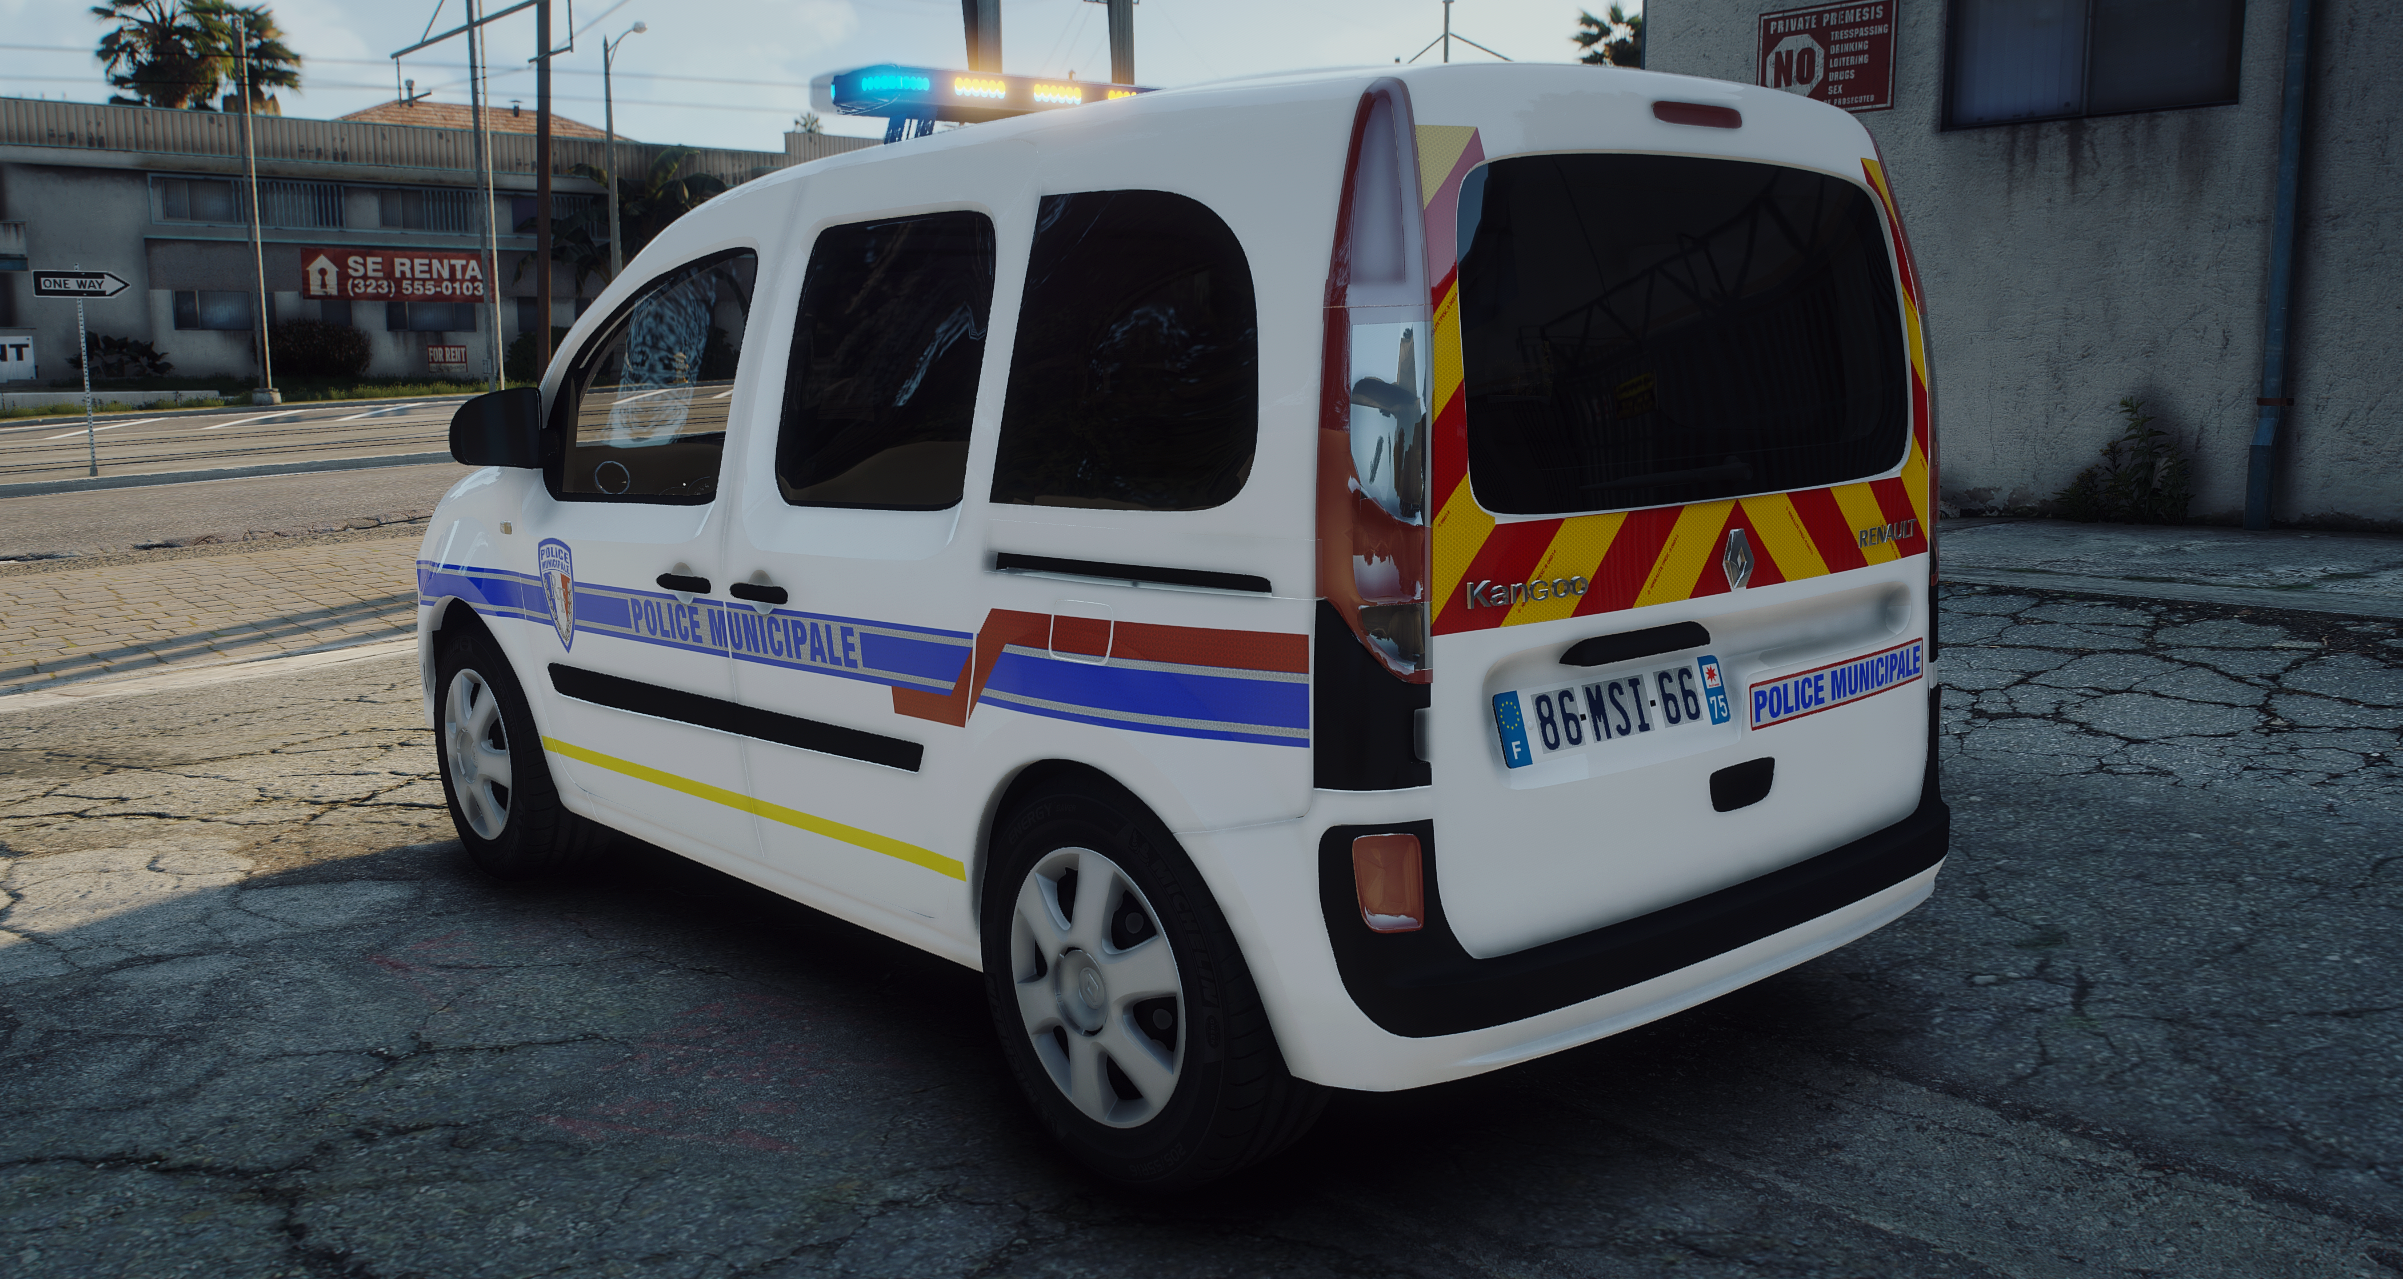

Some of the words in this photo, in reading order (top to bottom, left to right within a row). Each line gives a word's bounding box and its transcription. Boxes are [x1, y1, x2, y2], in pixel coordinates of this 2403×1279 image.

[1769, 15, 1817, 35] PRIVATE
[1822, 5, 1884, 27] PREMESIS
[1830, 24, 1889, 41] TRESSPASSING
[1829, 40, 1869, 55] DRINKING
[1773, 46, 1817, 89] NO
[1829, 54, 1869, 68] LOITERING
[1828, 69, 1855, 82] DRUGS
[1827, 84, 1843, 95] SEX
[1833, 94, 1875, 106] PROSECUTED
[347, 255, 384, 277] SE
[394, 257, 483, 280] RENTA
[42, 278, 71, 289] ONE
[76, 279, 105, 290] WAY
[347, 278, 395, 297] (323)
[401, 279, 484, 296] 555-0103
[428, 346, 444, 362] FOR
[445, 346, 466, 362] RENT
[1858, 518, 1918, 549] RENAULT
[540, 546, 570, 564] POLICE
[629, 597, 703, 644] POLICE
[707, 608, 858, 669] MUNICIPALE
[1753, 673, 1826, 724] POLICE
[1830, 644, 1921, 702] MUNICIPALE
[1709, 694, 1729, 720] 75
[1511, 740, 1522, 761] F
[1008, 802, 1052, 845] ENERGY
[1150, 857, 1219, 1007] MICHELIN
